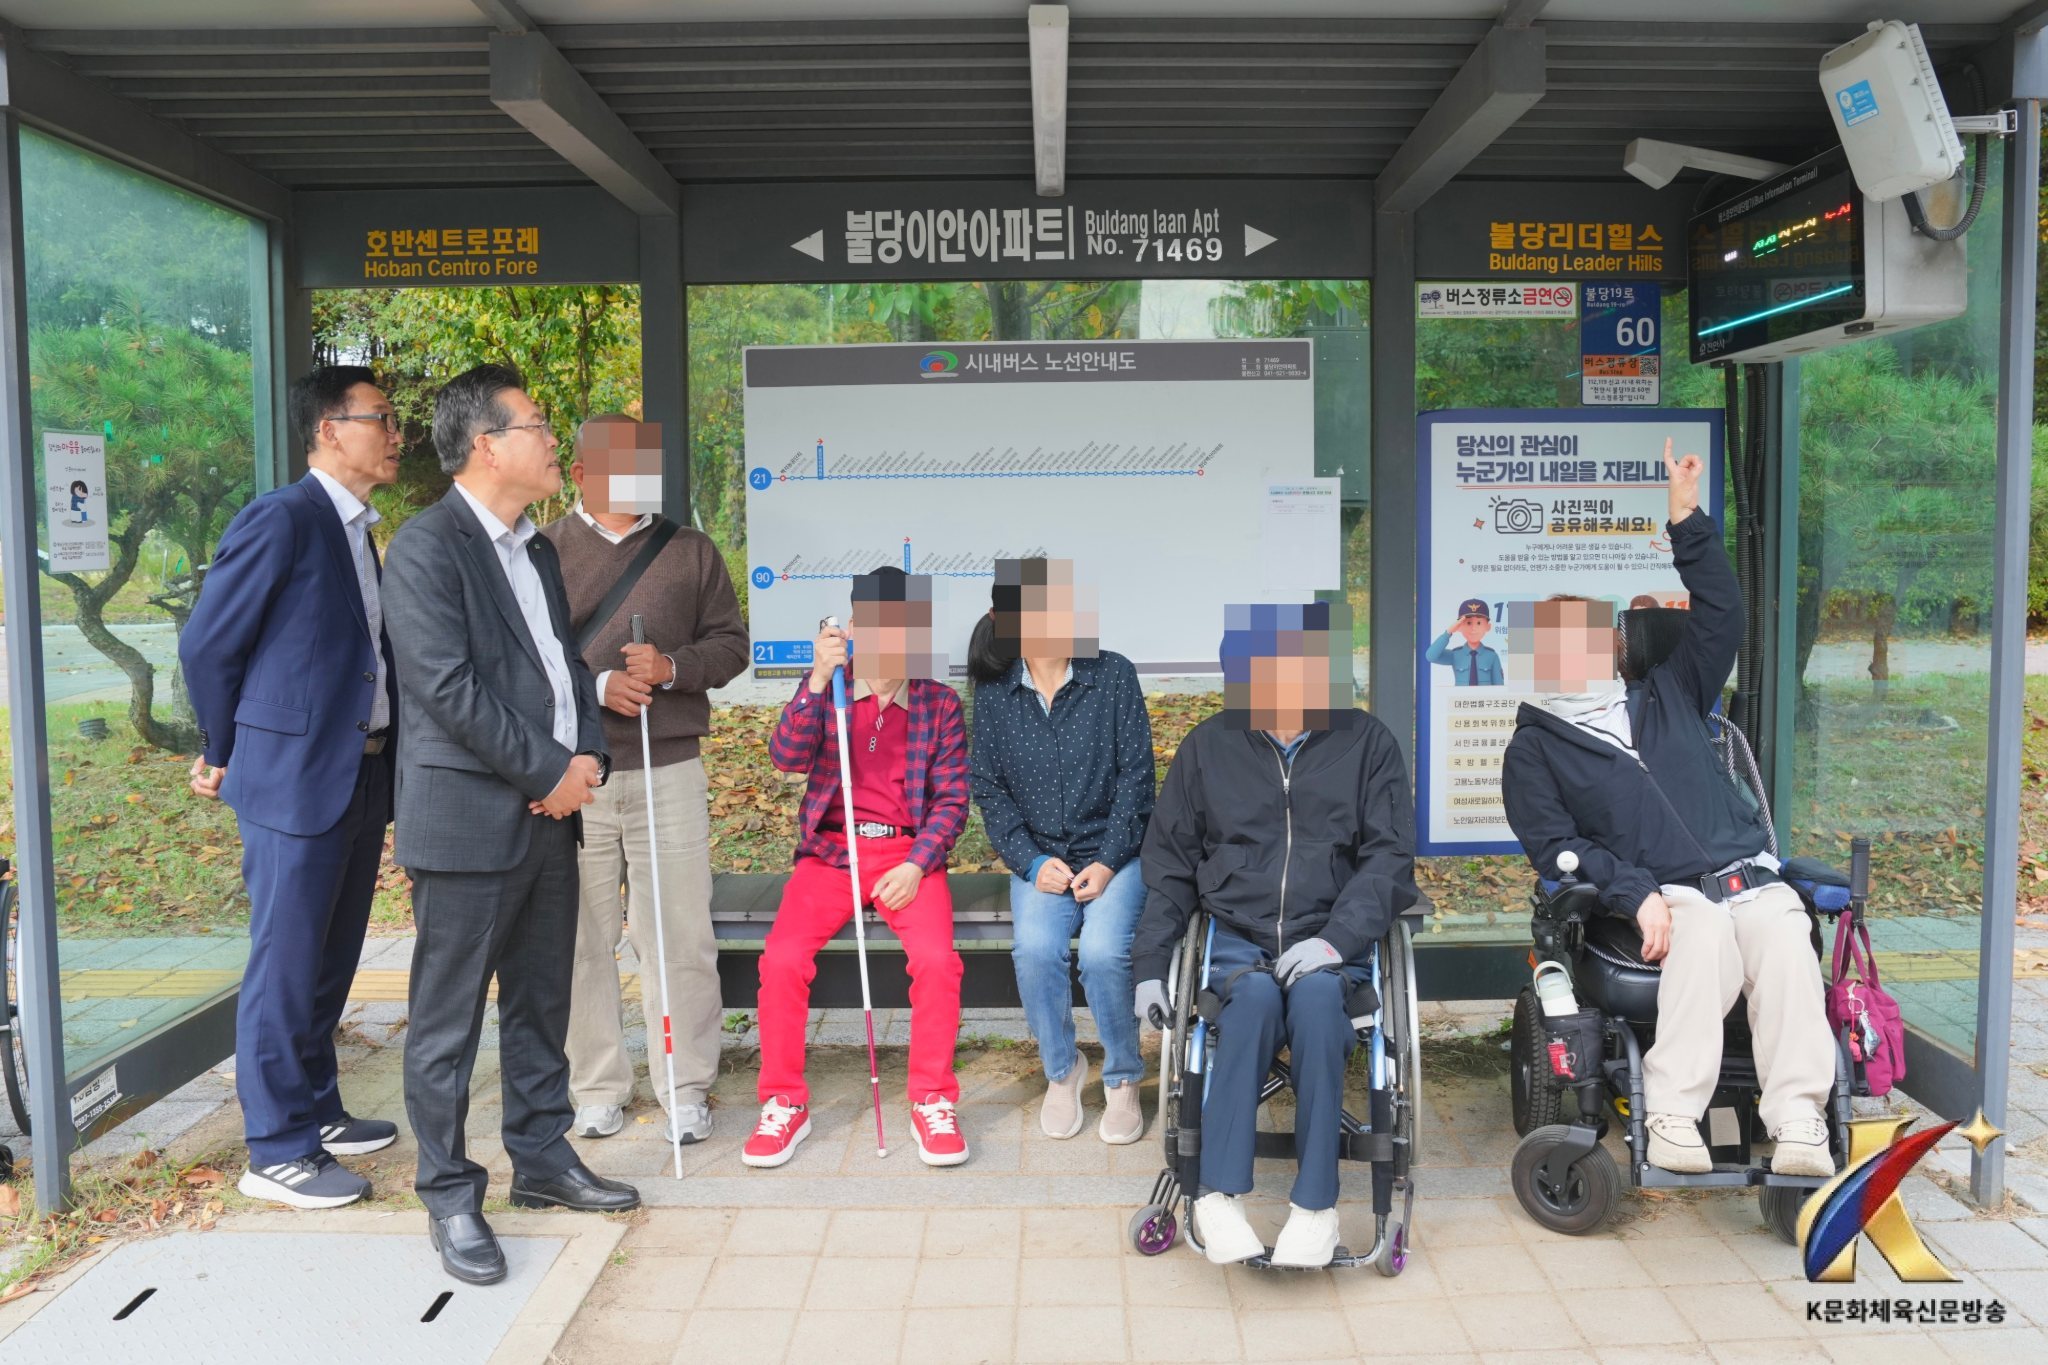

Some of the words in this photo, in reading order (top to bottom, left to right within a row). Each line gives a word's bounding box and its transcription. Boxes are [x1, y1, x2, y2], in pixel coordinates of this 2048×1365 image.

[1085, 210, 1149, 238] Buldang
[1192, 208, 1220, 237] Apt
[365, 228, 540, 257] 호반센트로포레
[845, 208, 1066, 263] 불당이안아파트
[1489, 222, 1664, 251] 불당리더힐스
[1087, 235, 1124, 256] No.
[1132, 238, 1223, 264] 71469
[364, 258, 424, 278] Hoban
[428, 258, 491, 277] Centro
[495, 258, 538, 276] Fore
[1489, 253, 1558, 274] Buldang
[1563, 254, 1623, 272] Leader
[1628, 254, 1663, 272] Hills
[1446, 287, 1553, 306] 버스정류소금연
[1586, 287, 1634, 301] 불당19로
[1616, 317, 1655, 346] 60
[965, 352, 1039, 373] 시내버스
[1044, 351, 1137, 372] 노선안내도
[1584, 356, 1638, 369] 버스정류장
[1456, 435, 1515, 456] 당신의
[1520, 435, 1578, 456] 관심이
[753, 473, 767, 484] 21
[1456, 461, 1534, 483] 누군가의
[1540, 461, 1597, 482] 내일을
[1551, 500, 1614, 515] 사진찍어
[1551, 517, 1652, 533] 공유해주세요!
[755, 572, 770, 583] 90
[755, 645, 774, 660] 21
[1453, 797, 1504, 805] 여성새로일하기
